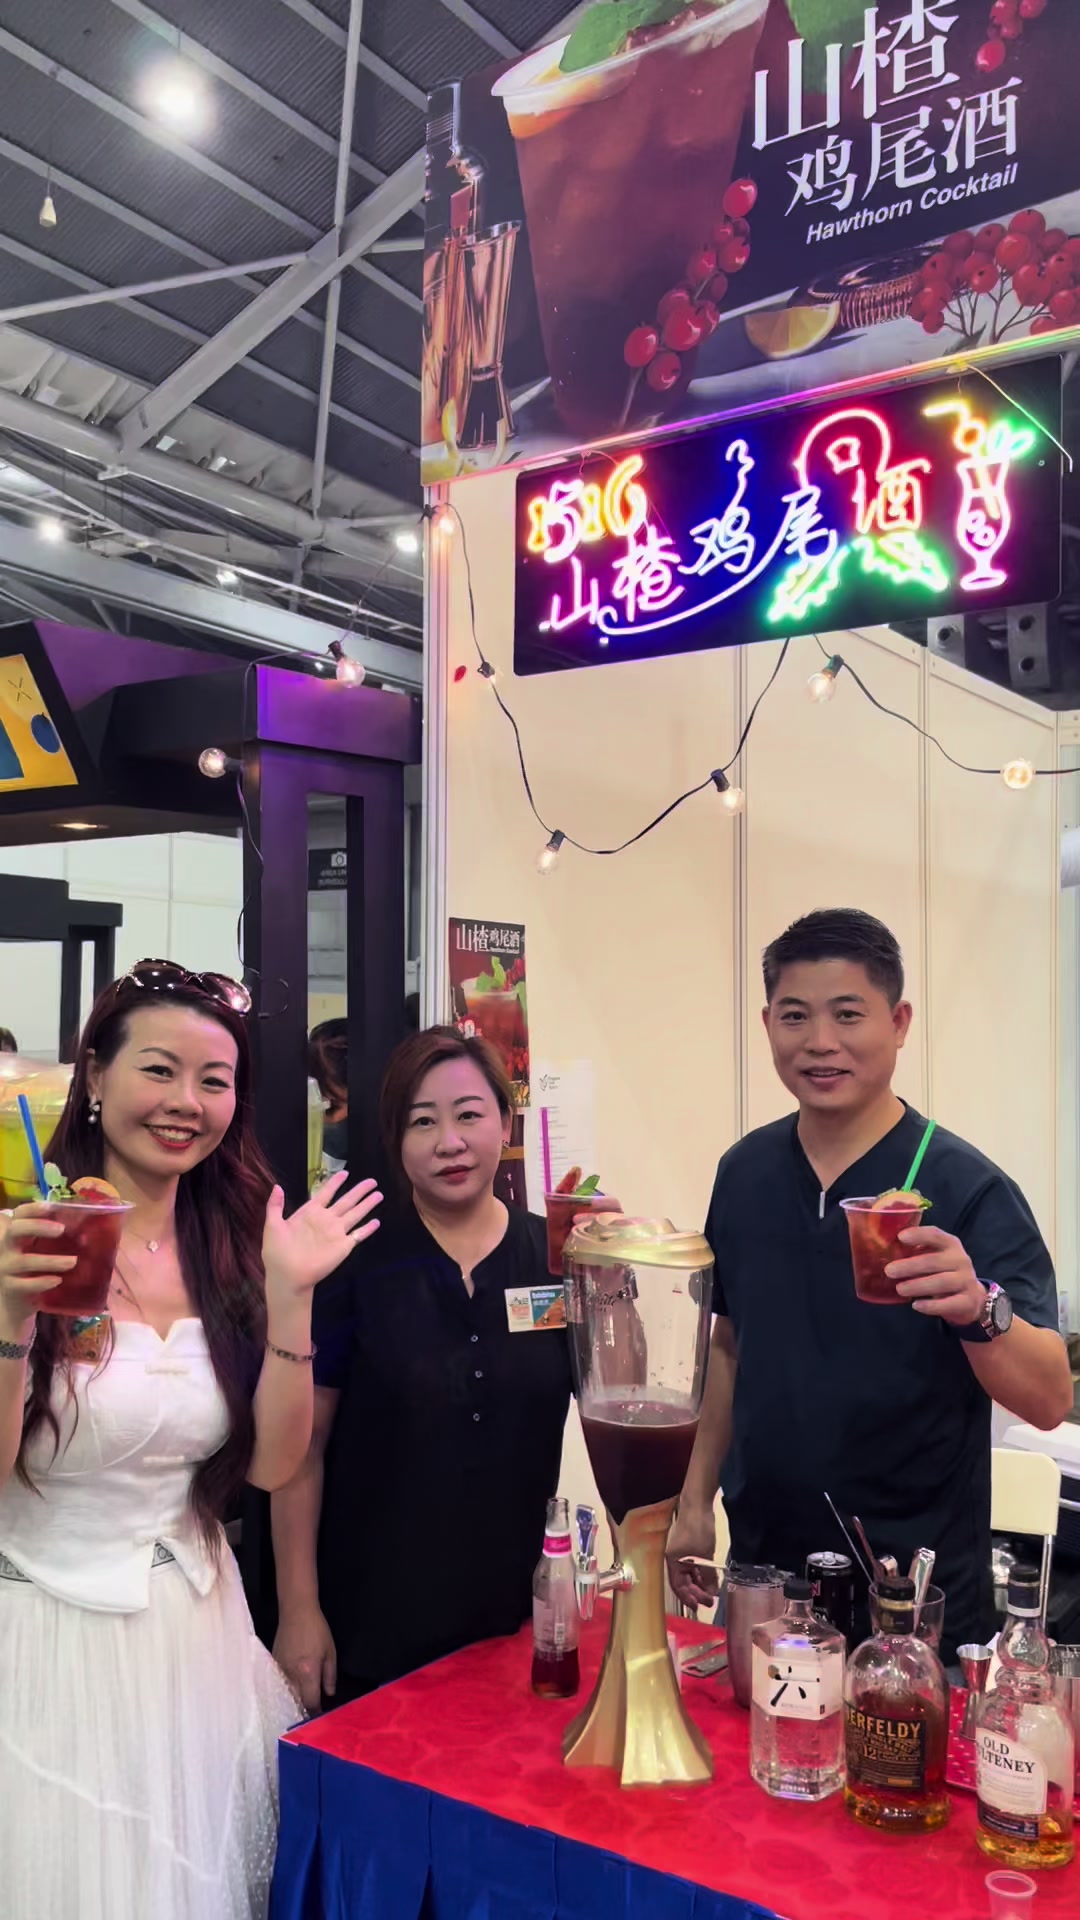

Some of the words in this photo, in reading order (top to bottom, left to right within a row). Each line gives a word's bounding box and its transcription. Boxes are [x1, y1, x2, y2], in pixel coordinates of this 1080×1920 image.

[752, 0, 959, 149] 山楂
[784, 76, 1023, 217] 鸡尾酒
[806, 199, 913, 244] Hawthorn
[920, 162, 1018, 210] Cocktail
[979, 1746, 1036, 1774] LTENEY
[983, 1736, 1010, 1755] OLD
